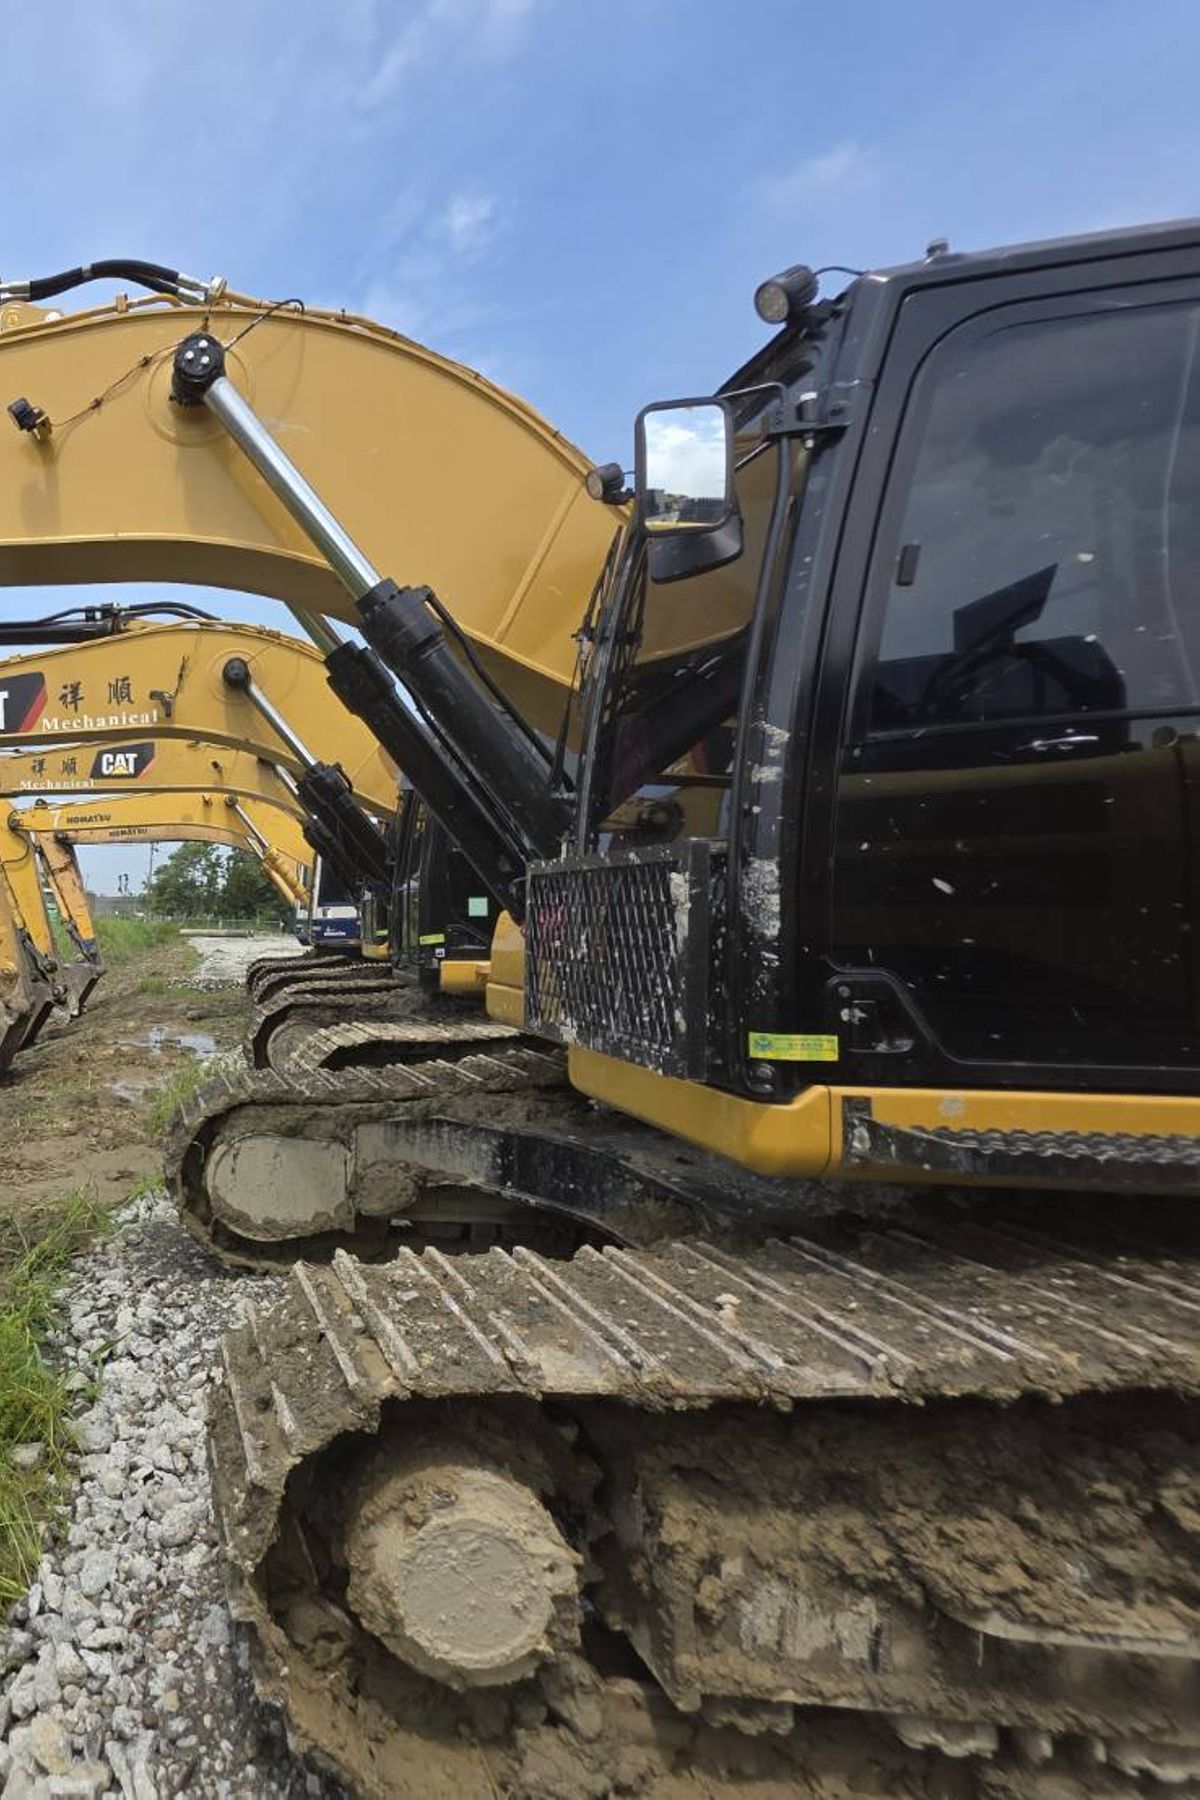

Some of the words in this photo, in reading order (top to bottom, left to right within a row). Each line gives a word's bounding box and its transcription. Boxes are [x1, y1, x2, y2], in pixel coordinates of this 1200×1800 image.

[58, 675, 134, 713] 祥順
[42, 709, 158, 731] Mechanical
[101, 752, 138, 775] CAT
[19, 778, 95, 790] Mechanical
[66, 814, 111, 824] KOMATSU
[109, 827, 148, 836] KOMATSU
